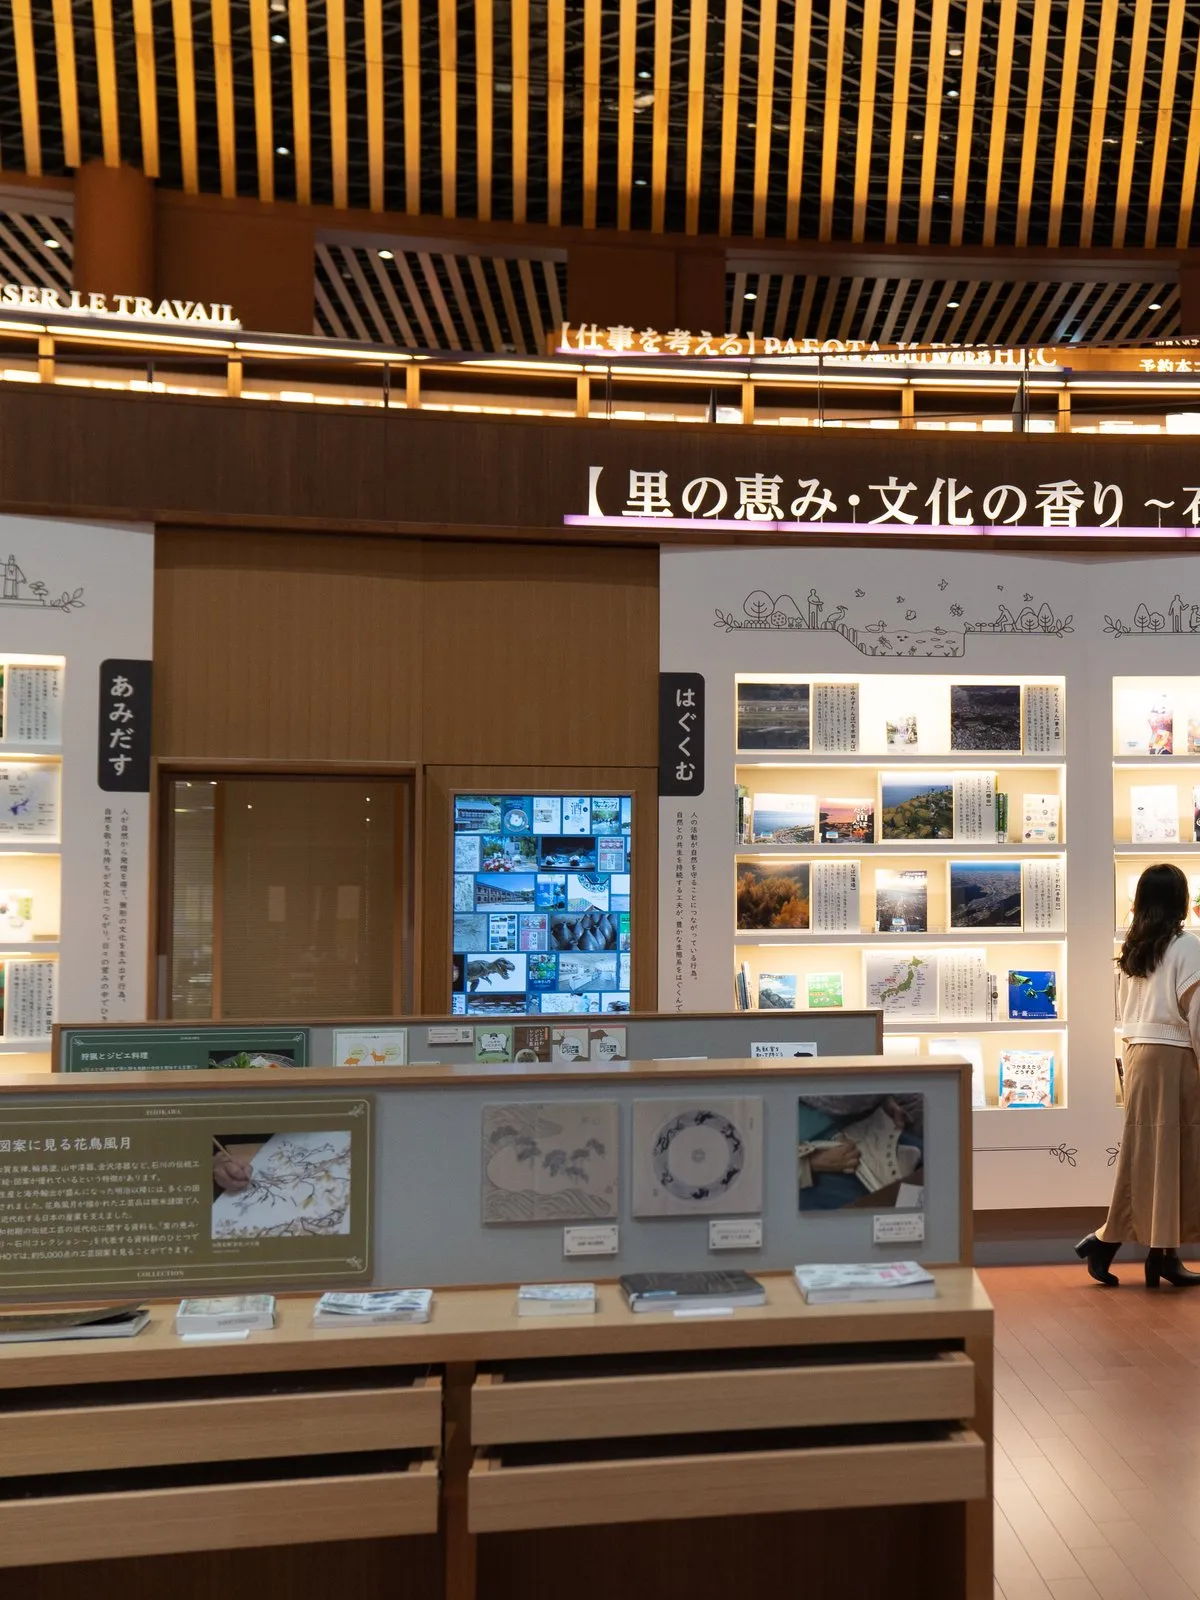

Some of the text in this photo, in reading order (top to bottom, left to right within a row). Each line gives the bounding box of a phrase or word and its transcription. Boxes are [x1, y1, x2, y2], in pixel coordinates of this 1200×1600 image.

[69, 290, 108, 314] LE
[113, 294, 240, 325] TRAVAIL
[560, 321, 755, 356] 【仕事を考える】
[109, 675, 134, 776] あみだす
[675, 688, 697, 782] はぐくむ
[690, 811, 698, 981] 人の活動が自然を守ることにつながっている行為。
[81, 1052, 149, 1061] 狩猟とジビエ料理
[0, 1136, 132, 1153] 図案に見る花鳥風月
[137, 1270, 185, 1278] COLLECTION
